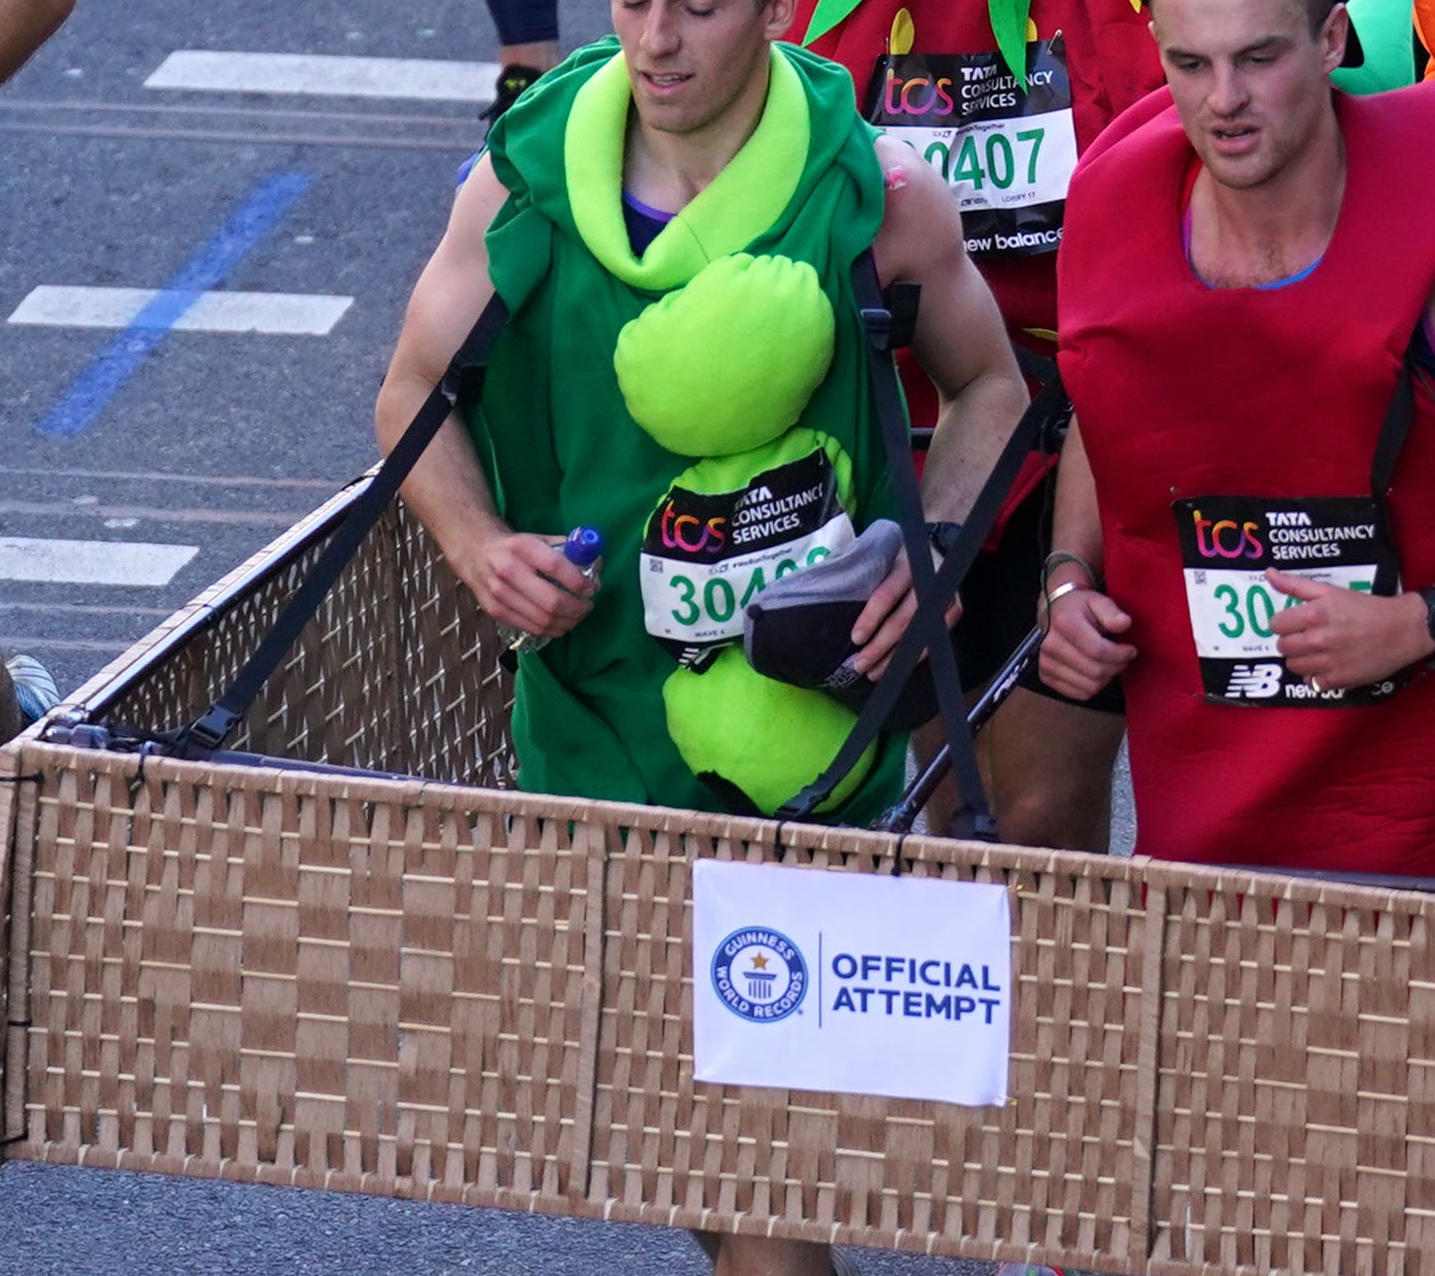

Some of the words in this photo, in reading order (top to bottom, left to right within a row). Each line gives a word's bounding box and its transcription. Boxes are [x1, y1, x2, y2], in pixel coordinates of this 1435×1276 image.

[961, 64, 998, 82] TATA
[884, 68, 954, 116] tcs
[961, 92, 1016, 116] SERVICES
[902, 127, 1046, 191] 0407
[995, 227, 1063, 250] balance
[731, 482, 824, 528] CONSULTANCY
[1265, 512, 1312, 527] TATA
[661, 499, 726, 553] tcs
[732, 512, 801, 545] SERVICES
[1192, 509, 1264, 559] tcs
[1268, 524, 1375, 545] CONSULTANCY
[1271, 543, 1341, 561] SERVICES
[724, 931, 796, 962] GUINNESS
[831, 952, 1002, 992] OFFICIAL
[716, 965, 751, 1013] WORLD
[753, 970, 804, 1018] RECORDS
[831, 987, 1001, 1026] ATTEMPT
